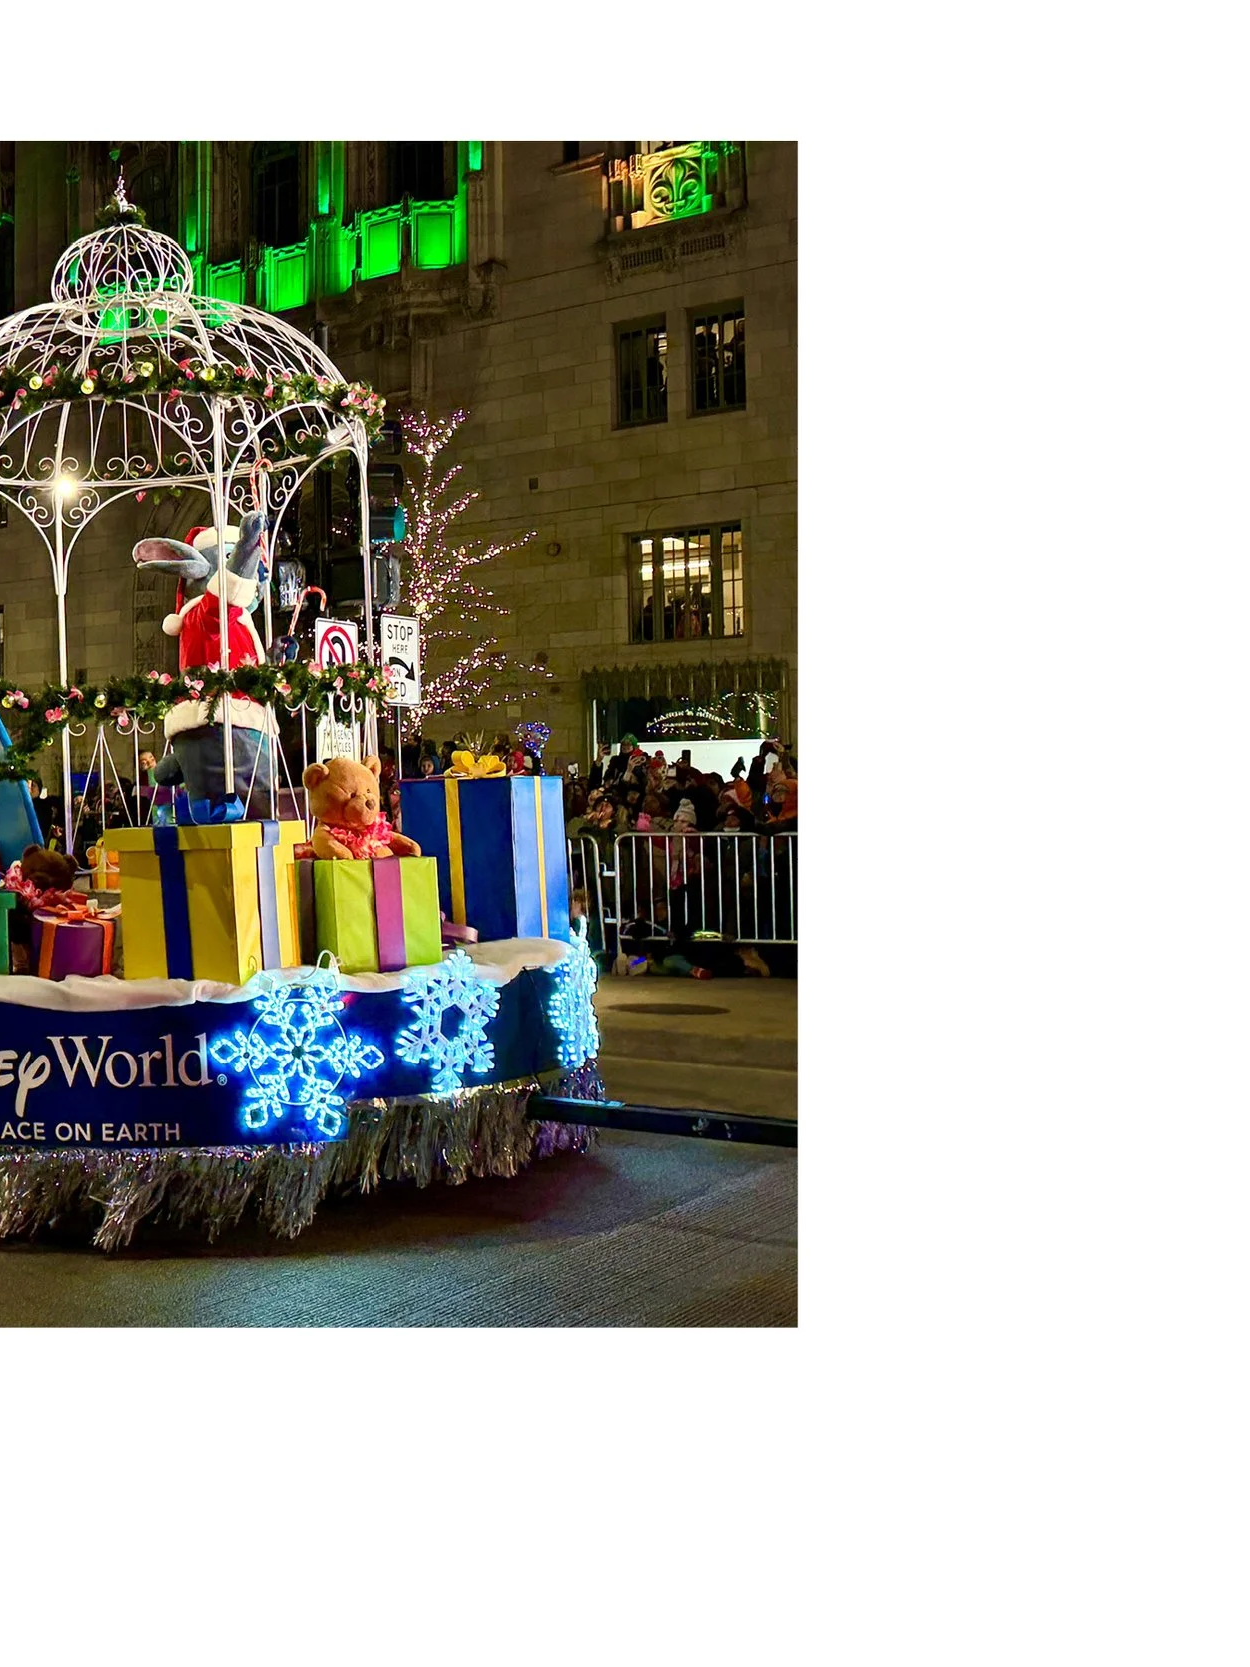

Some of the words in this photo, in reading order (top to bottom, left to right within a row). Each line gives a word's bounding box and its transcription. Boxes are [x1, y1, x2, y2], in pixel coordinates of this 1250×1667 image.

[387, 624, 414, 641] STOP
[392, 643, 409, 654] HERE
[55, 1122, 92, 1142] ON
[102, 1122, 181, 1142] EARTH
